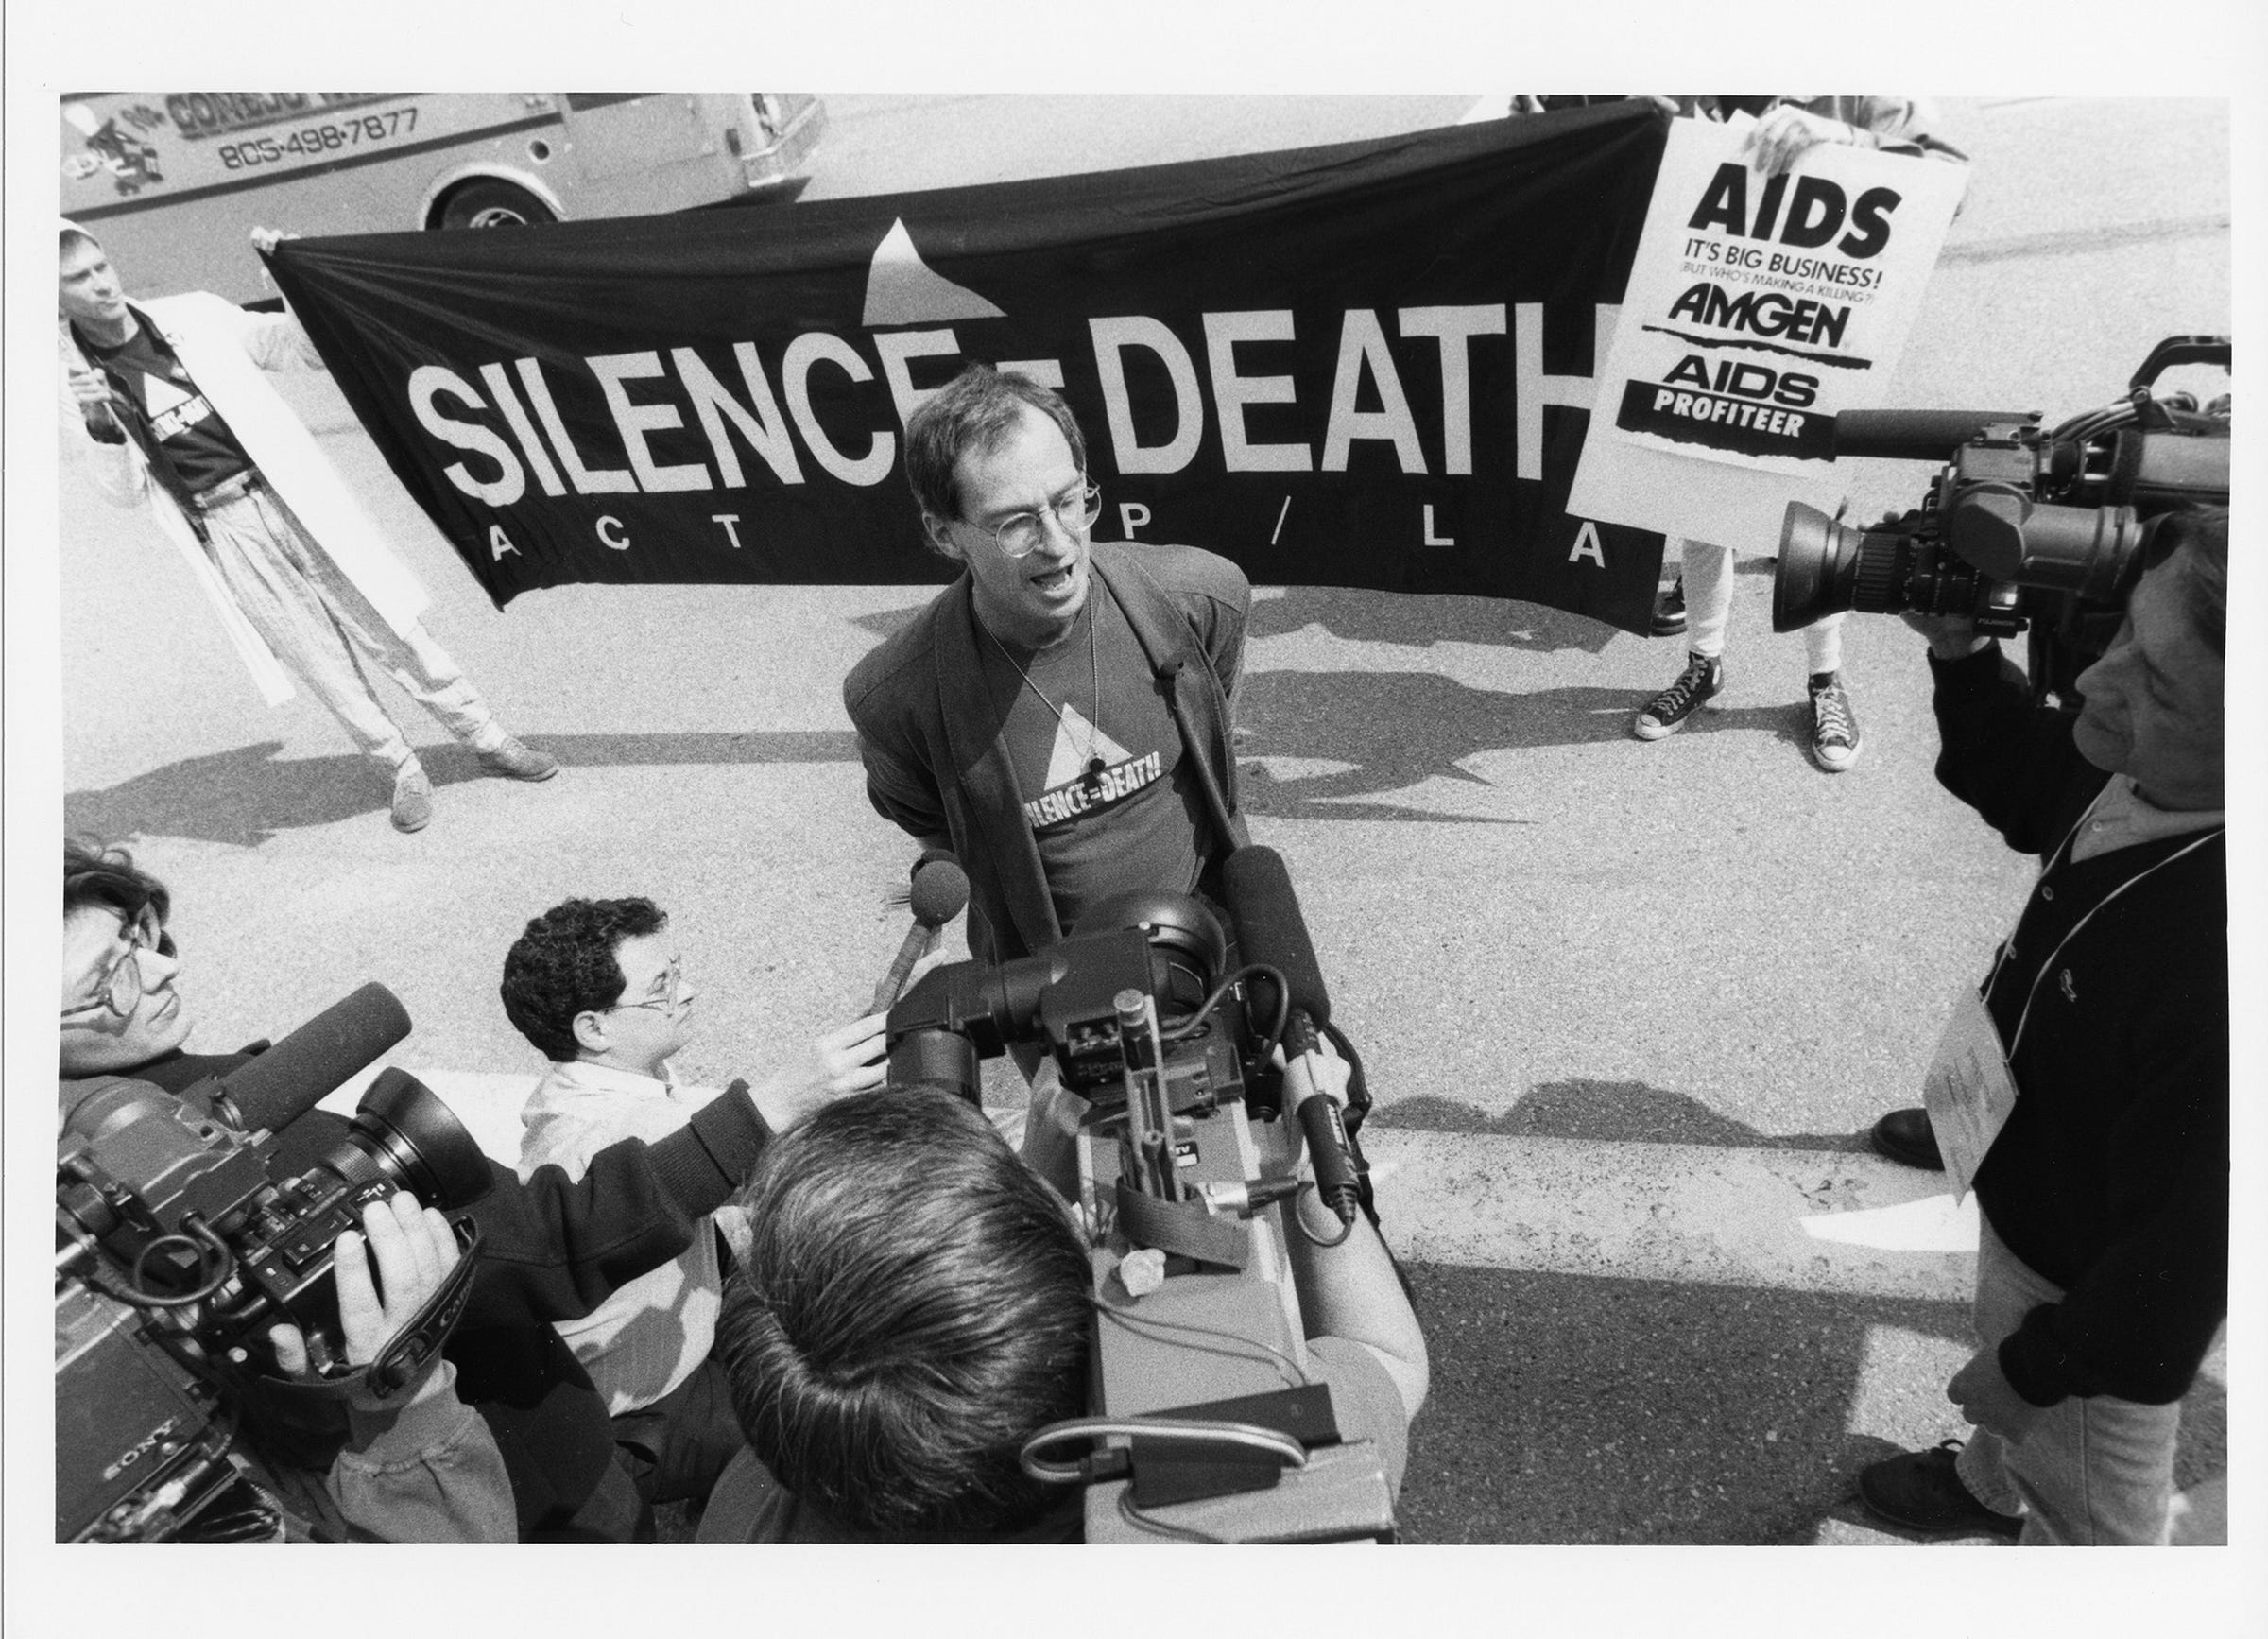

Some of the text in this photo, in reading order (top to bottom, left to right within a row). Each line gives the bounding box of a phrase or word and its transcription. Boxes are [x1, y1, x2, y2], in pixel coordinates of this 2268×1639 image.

[1688, 162, 1903, 260] AIDS
[1685, 238, 1883, 290] IT'S BIG BUSINESS!
[1751, 273, 1806, 292] MAKING
[1668, 282, 1851, 348] AMGEN
[1662, 354, 1820, 407] AIDS
[1653, 388, 1806, 438] PROFITEER
